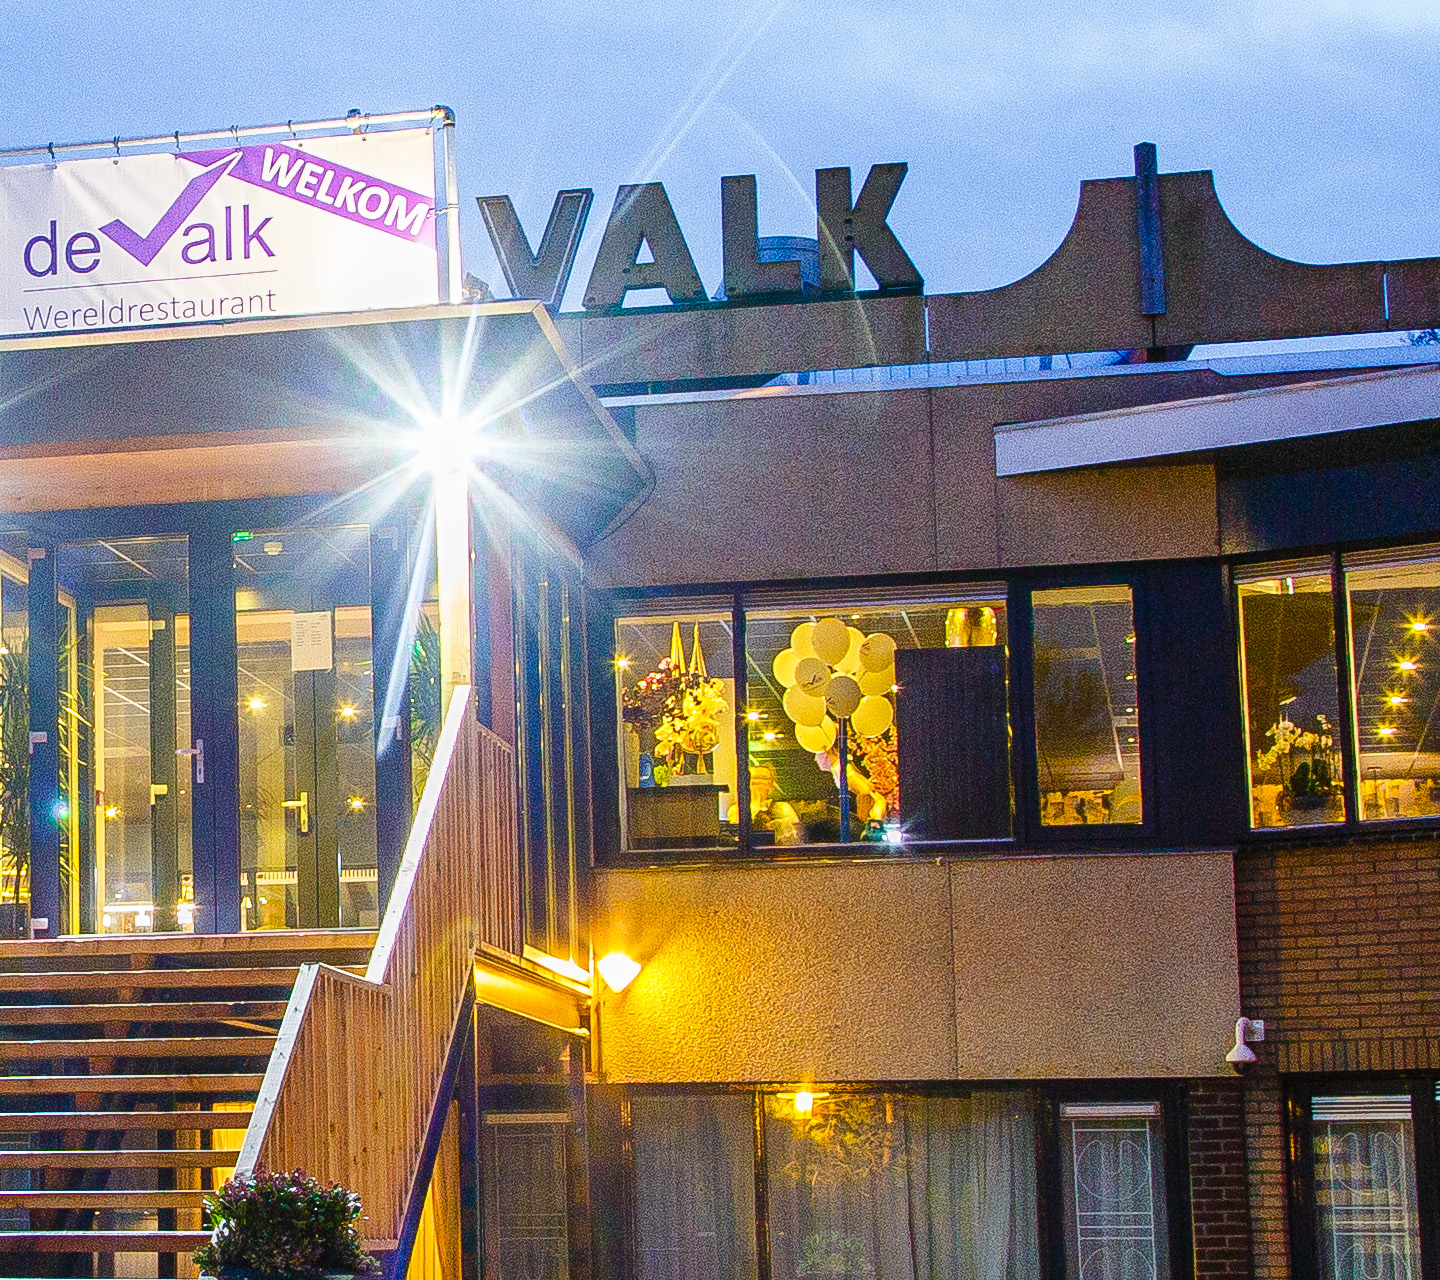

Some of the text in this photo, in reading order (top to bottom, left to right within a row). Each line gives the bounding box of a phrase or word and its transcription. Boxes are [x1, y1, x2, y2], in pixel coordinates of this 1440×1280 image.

[259, 146, 432, 238] WELKOM
[476, 162, 925, 312] VALK
[23, 289, 277, 331] Wereldrestaurant
